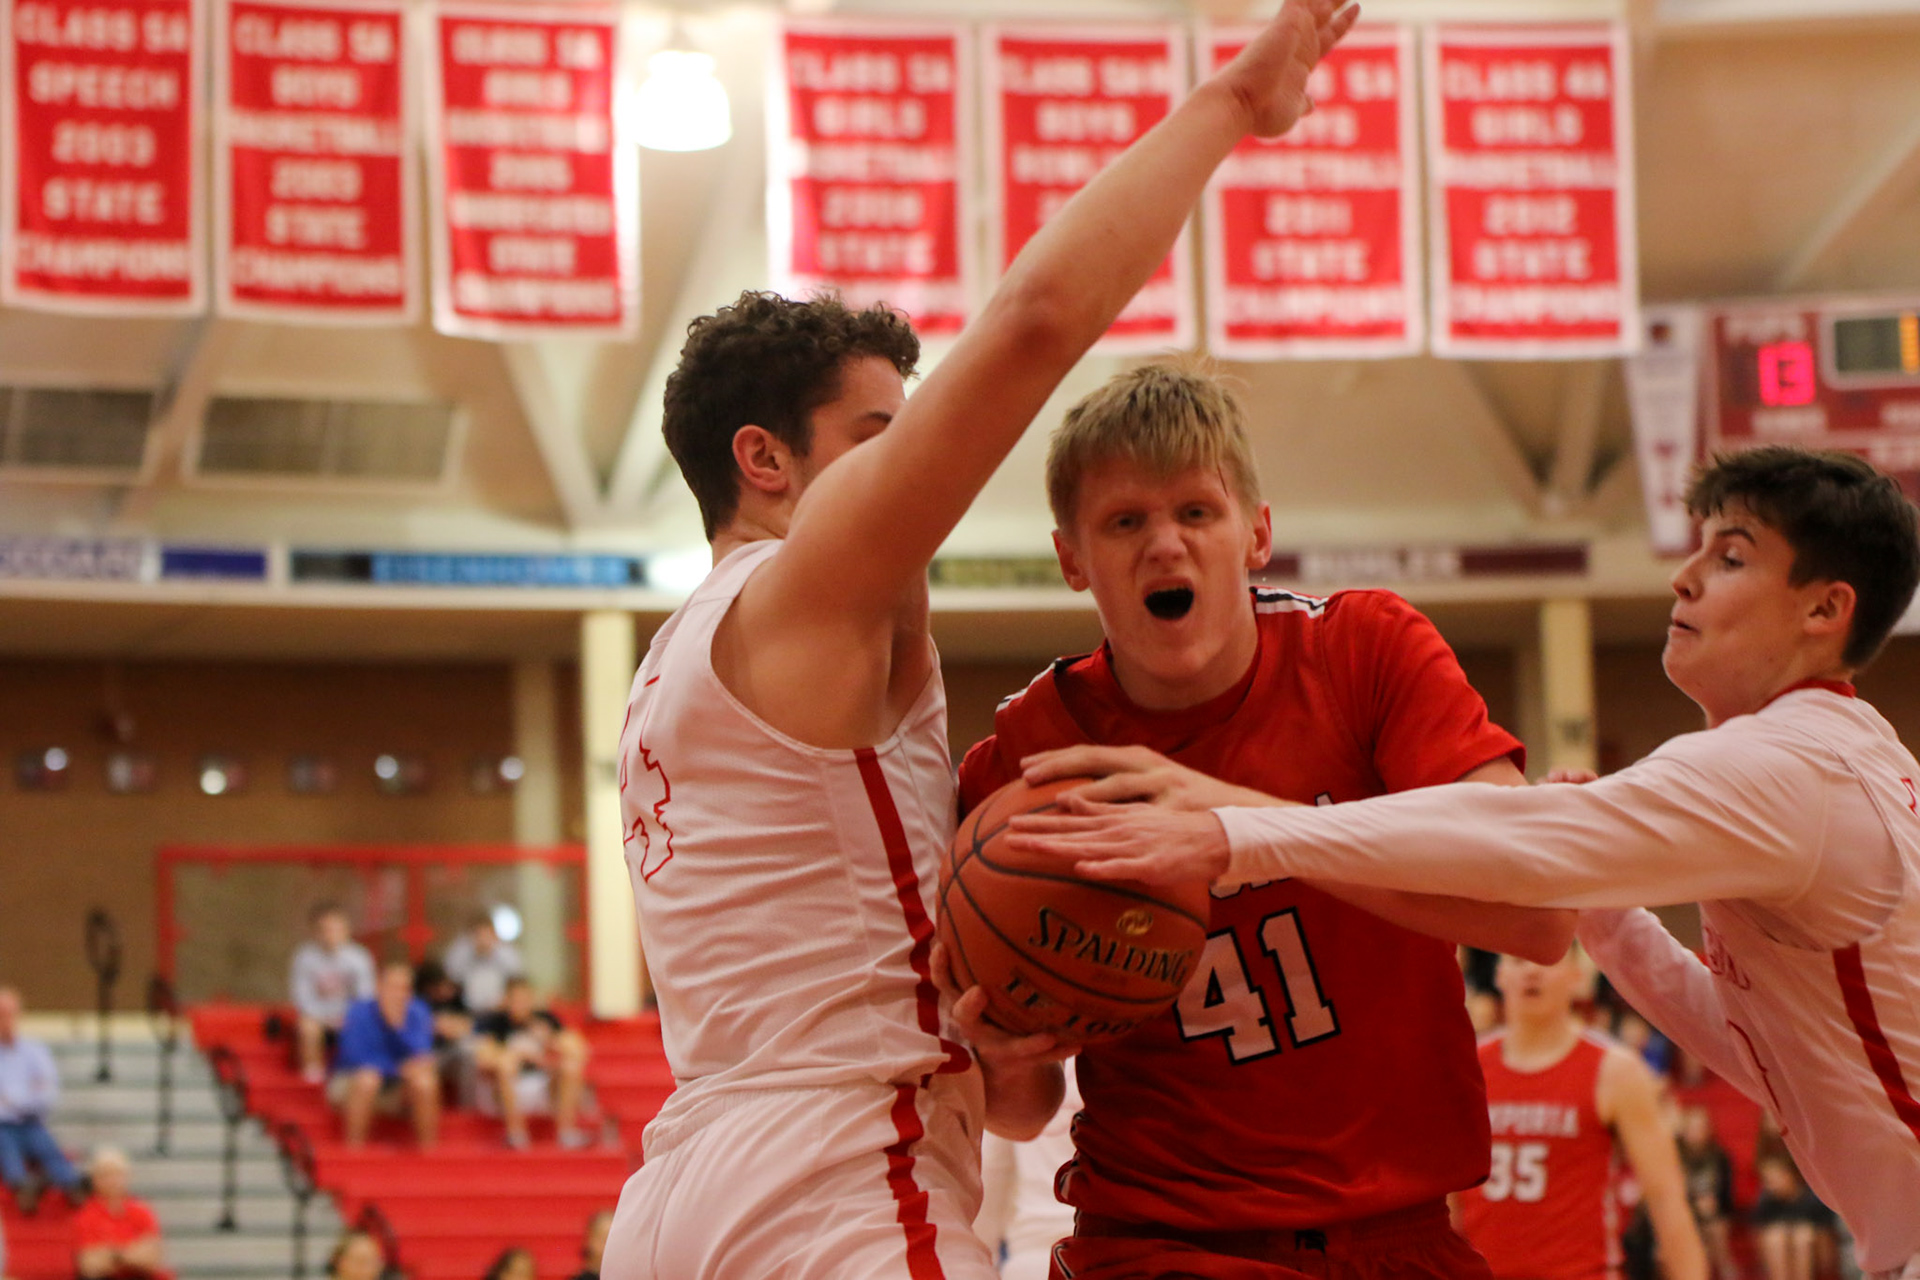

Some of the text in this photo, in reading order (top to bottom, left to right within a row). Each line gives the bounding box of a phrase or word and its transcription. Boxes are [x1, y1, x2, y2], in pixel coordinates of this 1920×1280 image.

[14, 4, 137, 50] CLASS
[232, 15, 341, 61] CLASS
[27, 60, 180, 109] SPEECH
[268, 65, 361, 108] BOYS
[791, 51, 897, 92] CLASS
[1441, 62, 1556, 100] CLASS
[812, 97, 926, 137] GIRLS
[1035, 102, 1133, 140] BOYS
[1470, 106, 1582, 145] GIRLS
[52, 119, 157, 167] 2003
[42, 178, 166, 225] STATE
[1483, 196, 1577, 236] 2012
[264, 203, 368, 250] STATE
[14, 235, 190, 284] CHAMPIONS
[817, 231, 935, 273] STATE
[1250, 239, 1368, 281] STATE
[1471, 239, 1592, 281] STATE
[229, 252, 403, 297] CHAMPIONS
[1029, 907, 1193, 987] SPALDING
[1172, 906, 1341, 1066] 41
